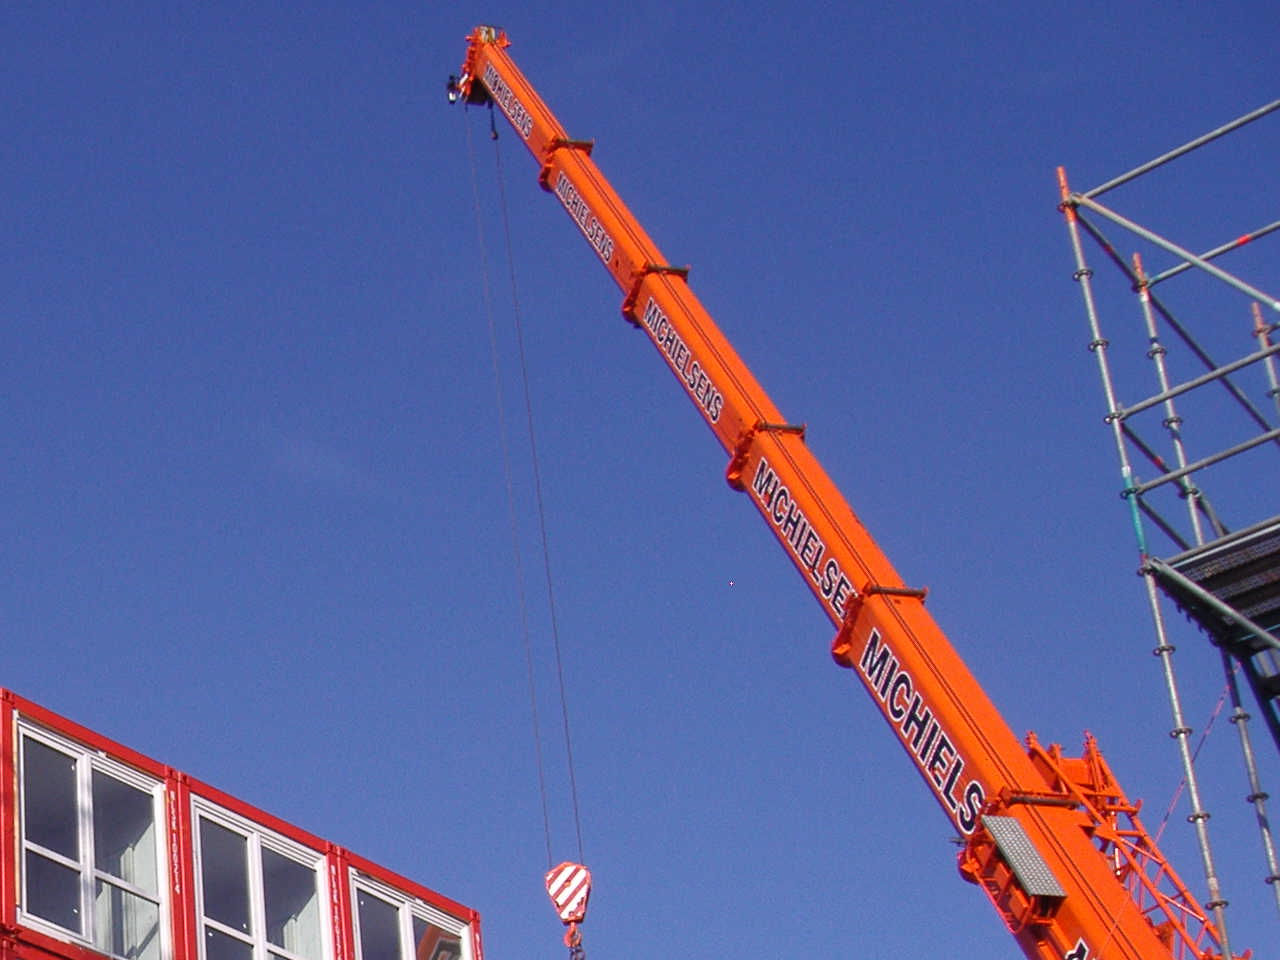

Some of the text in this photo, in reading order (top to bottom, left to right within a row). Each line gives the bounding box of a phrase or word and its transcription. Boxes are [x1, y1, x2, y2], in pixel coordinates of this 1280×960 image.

[482, 61, 534, 140] MICHIELSENS
[556, 171, 614, 264] MICHIELSENS
[644, 297, 724, 424] MICHIELSENS
[752, 457, 858, 623] MICHIELSE
[859, 627, 985, 834] MICHIELS
